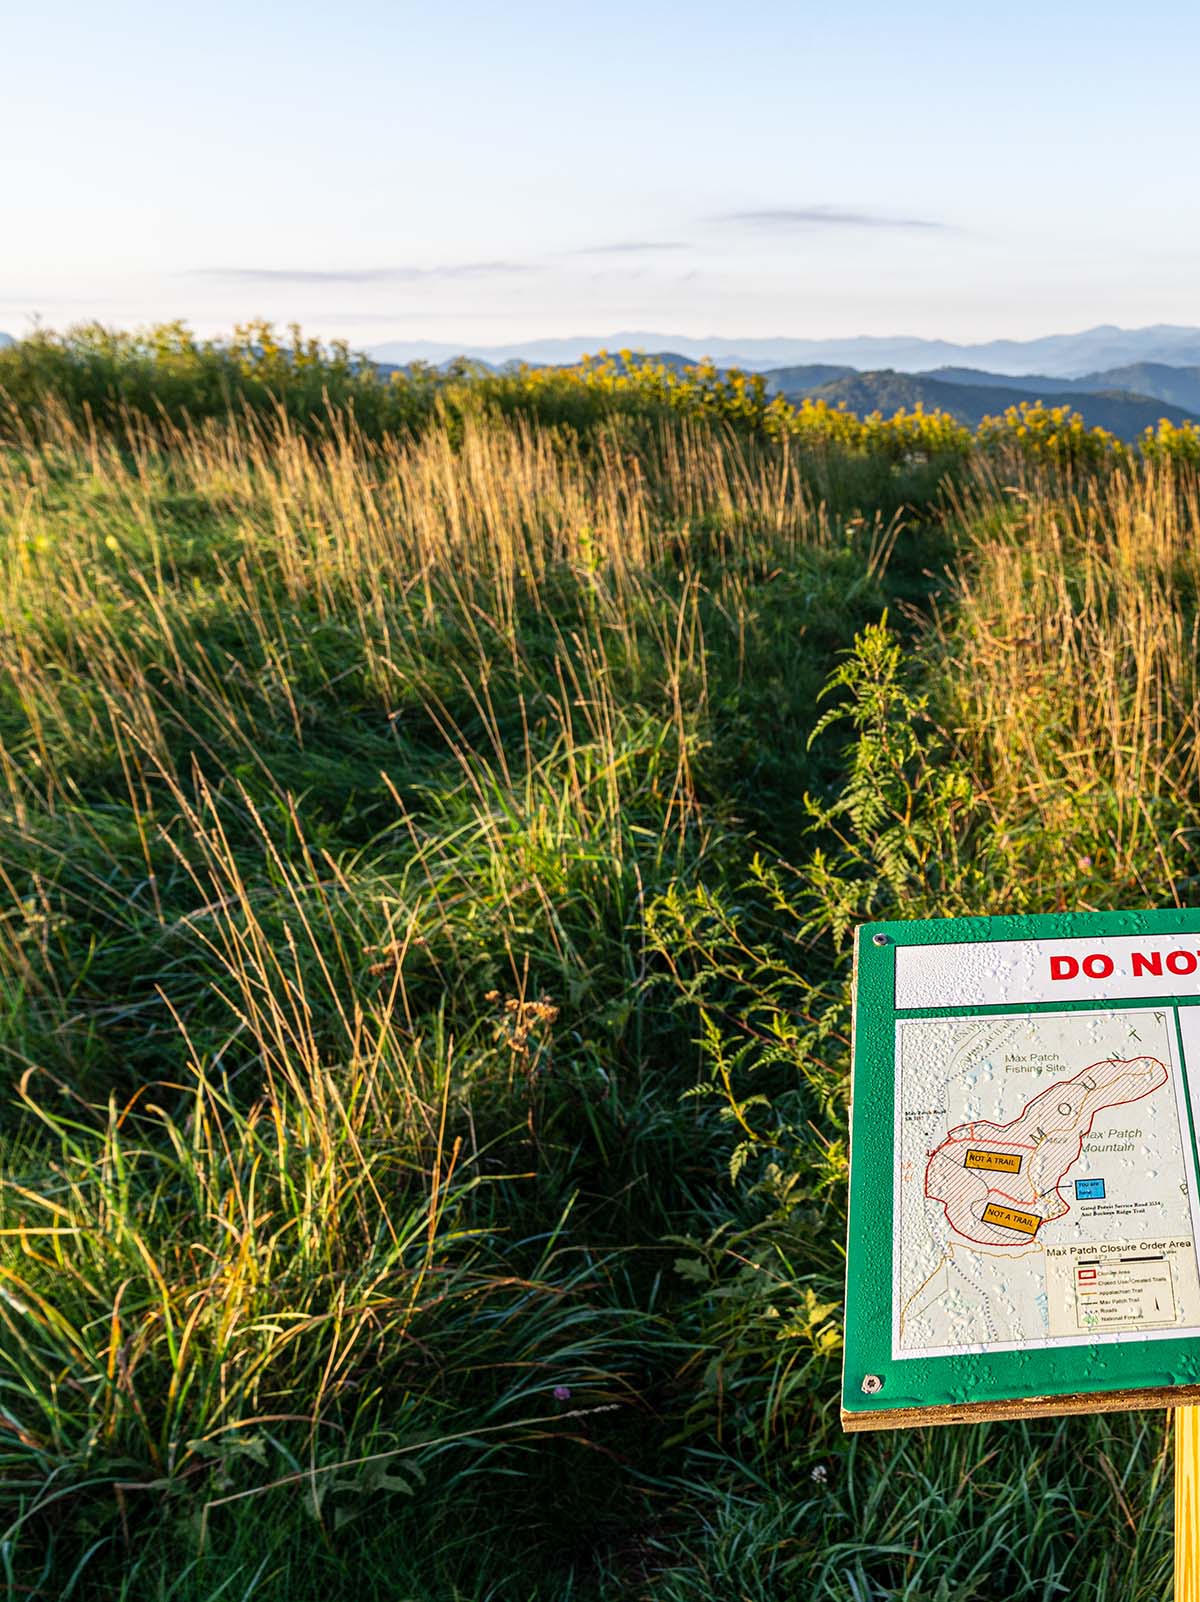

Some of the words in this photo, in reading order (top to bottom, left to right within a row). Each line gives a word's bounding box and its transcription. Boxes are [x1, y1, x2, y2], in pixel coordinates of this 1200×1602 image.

[1050, 954, 1114, 981] DO
[1005, 1054, 1027, 1063] Max
[1030, 1053, 1060, 1061] Patch
[1005, 1064, 1042, 1075] Fishing
[1046, 1063, 1066, 1072] Site
[1108, 1128, 1142, 1139] Patch
[1082, 1143, 1135, 1152] Mountain
[994, 1158, 1014, 1166] TRAIL
[987, 1209, 1004, 1218] NOT
[1013, 1216, 1033, 1227] TRAIL
[1047, 1248, 1067, 1257] Max
[1100, 1243, 1136, 1253] Closure
[1140, 1241, 1166, 1250] Order
[1169, 1240, 1191, 1248] Area
